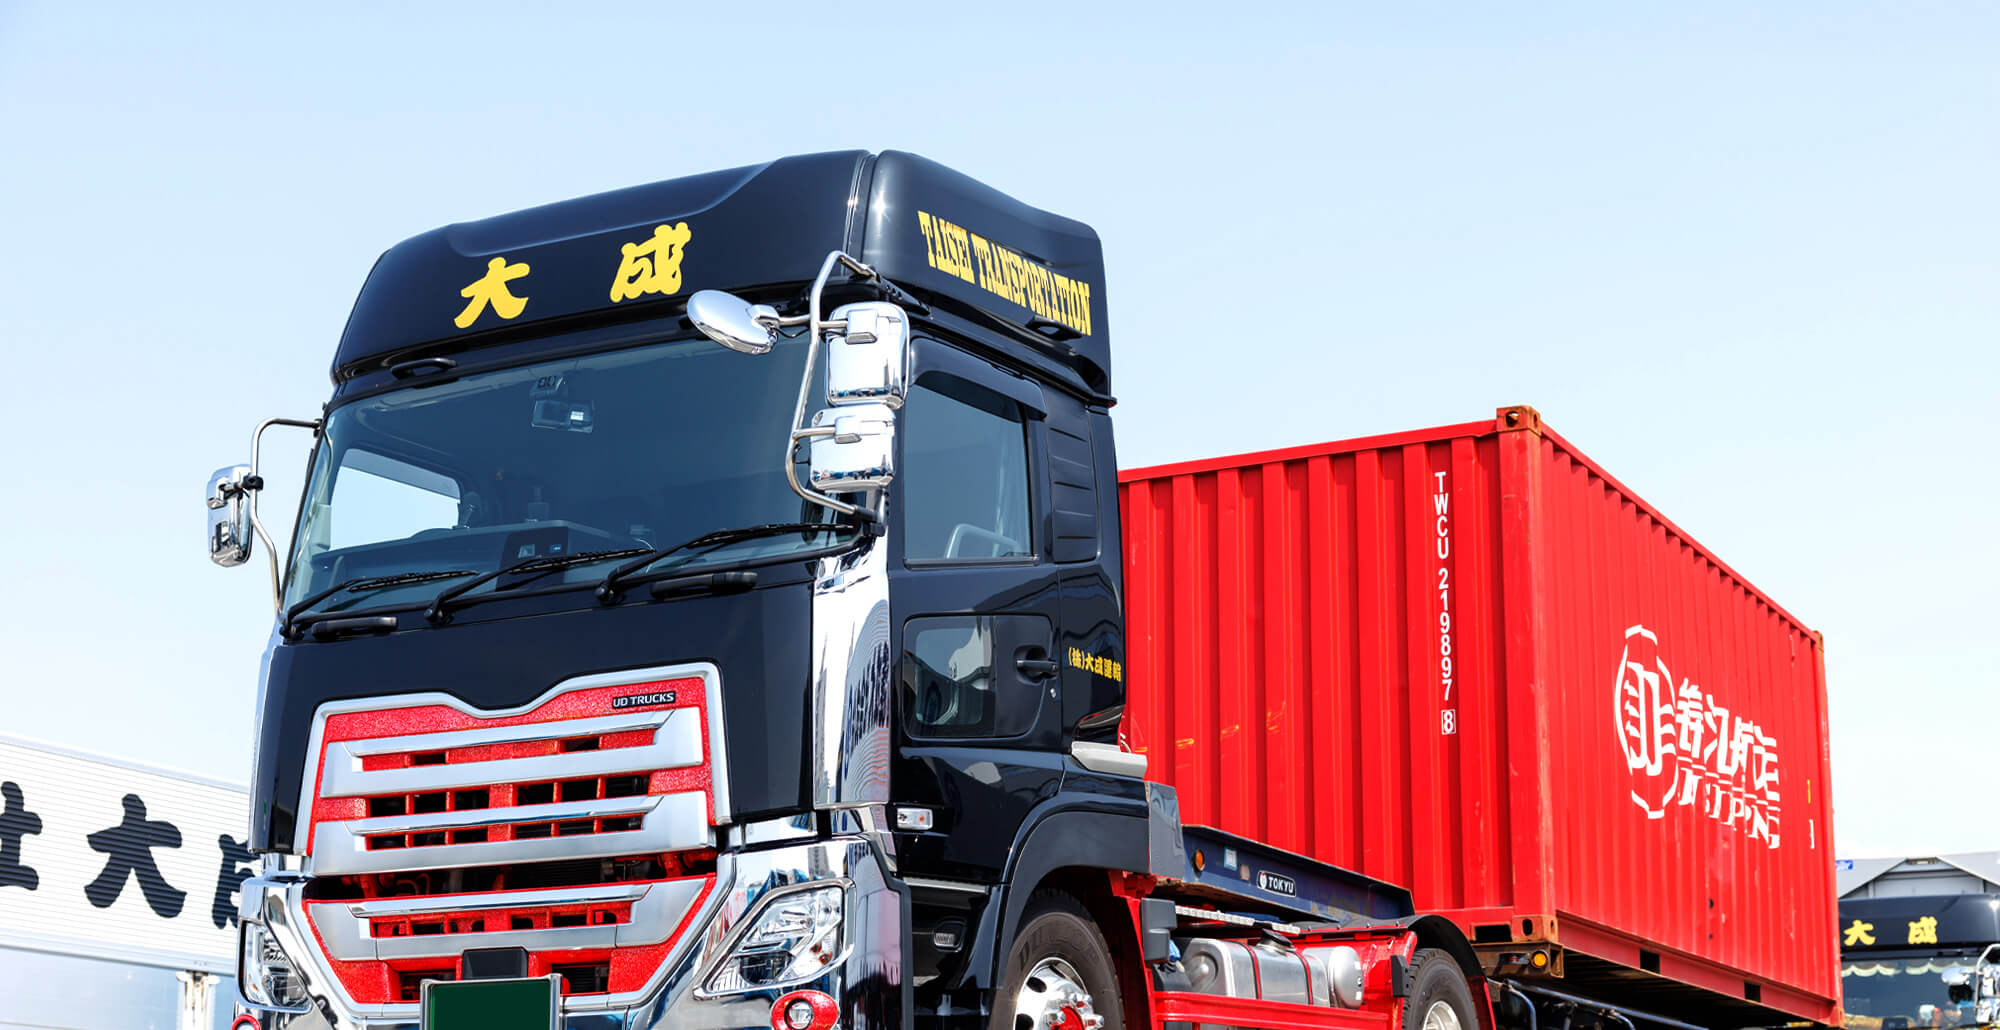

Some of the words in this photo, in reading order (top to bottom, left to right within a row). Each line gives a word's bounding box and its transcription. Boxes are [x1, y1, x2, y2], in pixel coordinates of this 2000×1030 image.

[453, 222, 692, 329] 大成
[917, 210, 976, 285] TAISEI
[970, 232, 1092, 336] TRANSPORTATION
[1433, 471, 1449, 560] TWCU
[1438, 567, 1453, 701] 219897
[613, 697, 628, 708] UD
[630, 692, 675, 705] TRUCKS
[1443, 709, 1454, 733] 8
[1268, 876, 1294, 894] TOKYU
